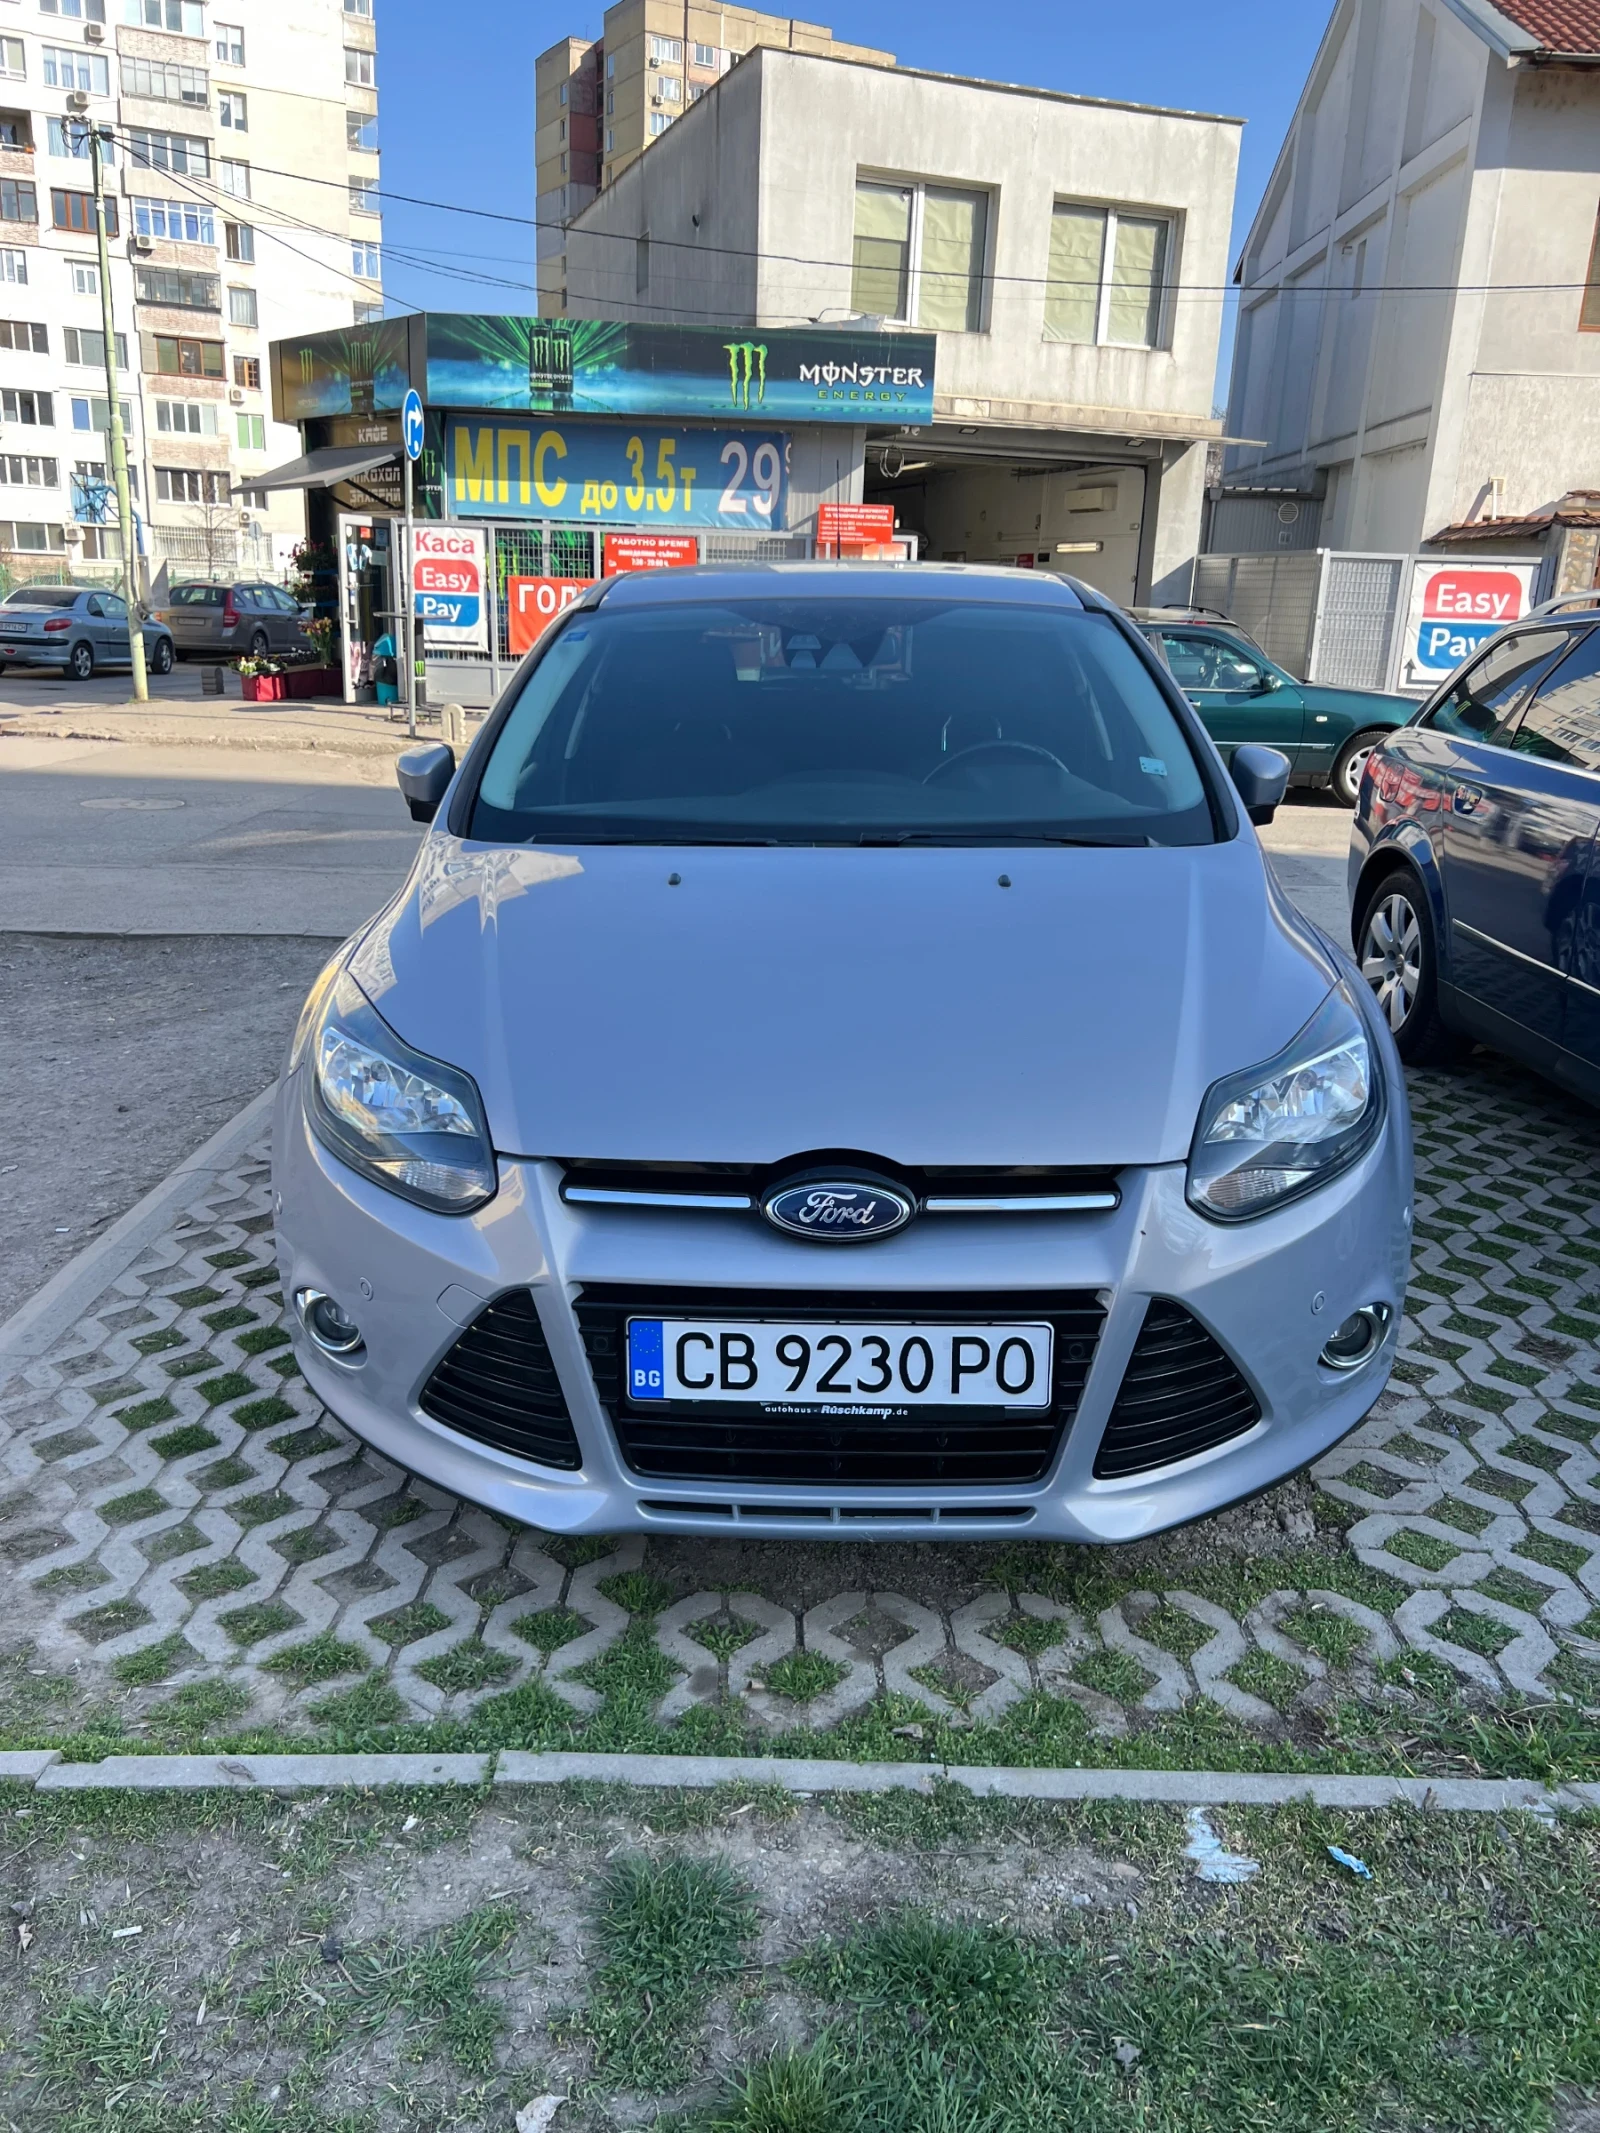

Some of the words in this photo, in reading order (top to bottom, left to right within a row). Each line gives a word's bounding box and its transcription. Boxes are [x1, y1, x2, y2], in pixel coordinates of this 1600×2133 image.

[818, 390, 907, 401] ENERGY
[358, 424, 388, 443] КАФЕ
[455, 427, 568, 507] МПС
[580, 480, 618, 515] до
[718, 441, 780, 515] 29
[415, 531, 475, 554] Каса
[611, 537, 656, 547] РАБОТНО
[658, 539, 690, 548] ВРЕМЕ
[422, 567, 471, 592] Easy
[423, 597, 462, 623] Pay
[1436, 583, 1511, 619] Easy
[799, 1191, 876, 1224] Ford
[676, 1332, 758, 1390] CB
[775, 1334, 934, 1394] 9230
[634, 1369, 661, 1387] BG
